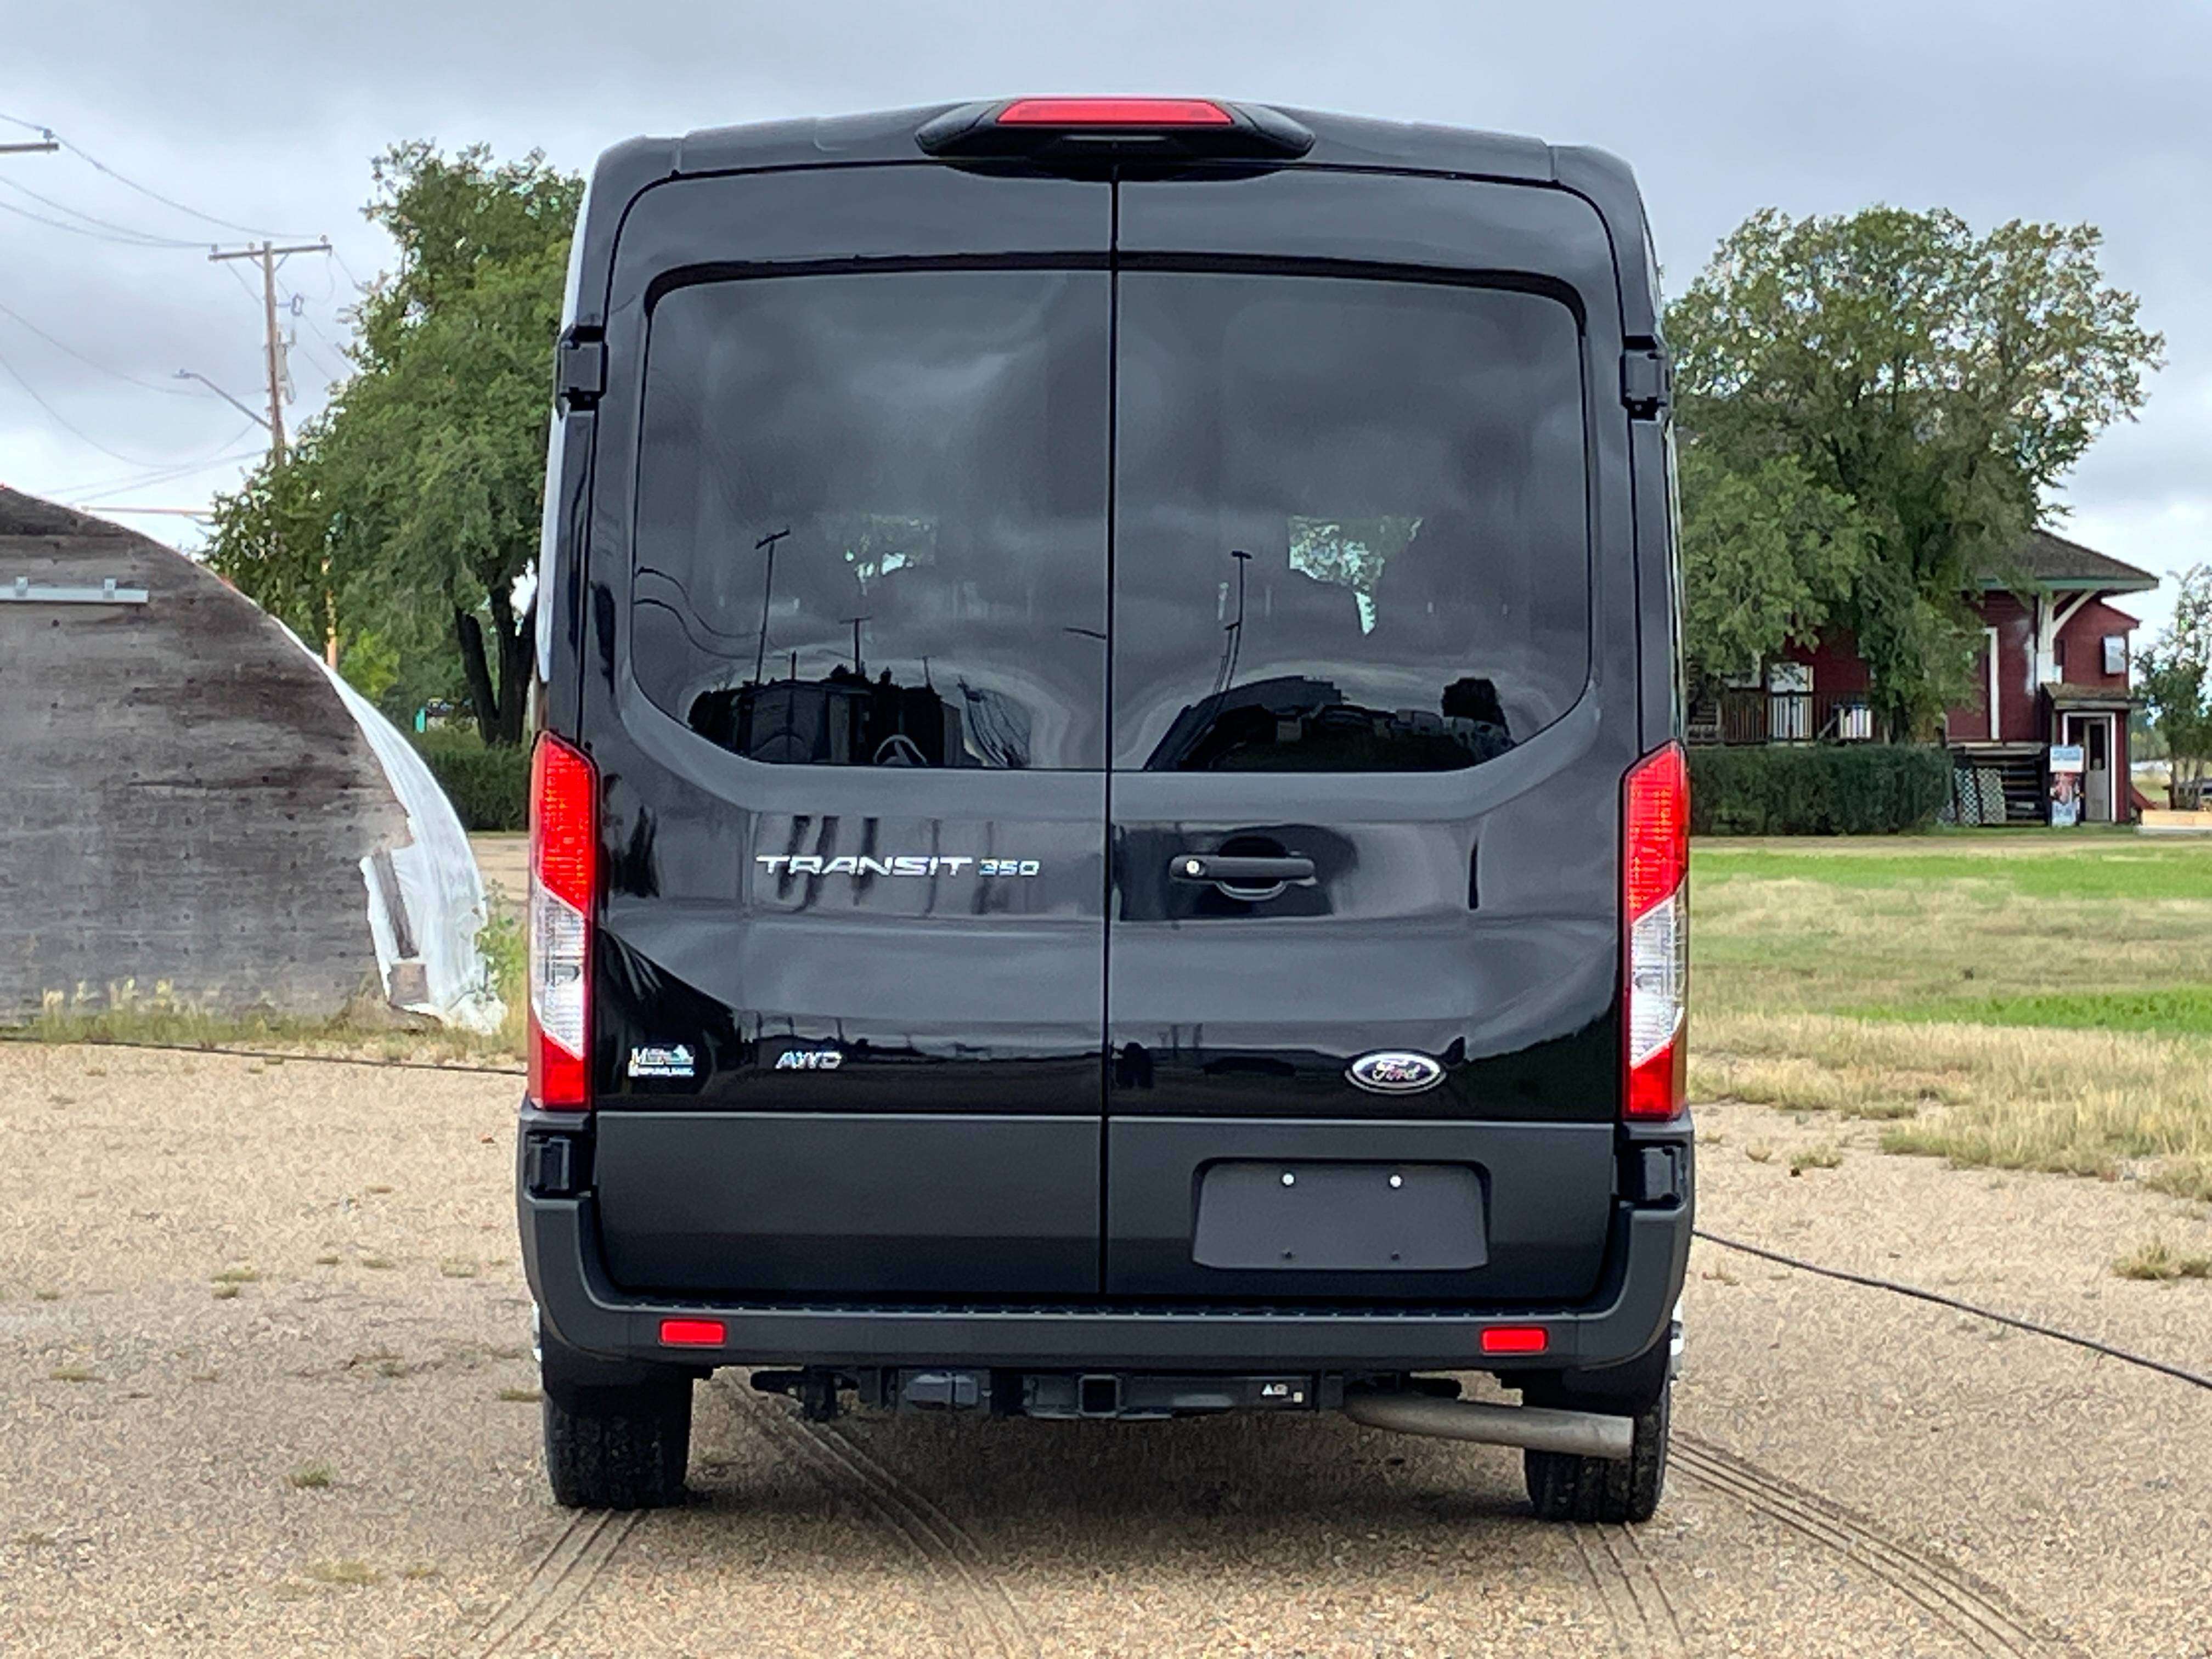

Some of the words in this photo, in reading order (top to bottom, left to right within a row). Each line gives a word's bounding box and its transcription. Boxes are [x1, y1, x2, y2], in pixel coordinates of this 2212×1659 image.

[755, 855, 973, 877] TRANSIT
[978, 858, 1040, 877] 350
[775, 1050, 842, 1069] AWD
